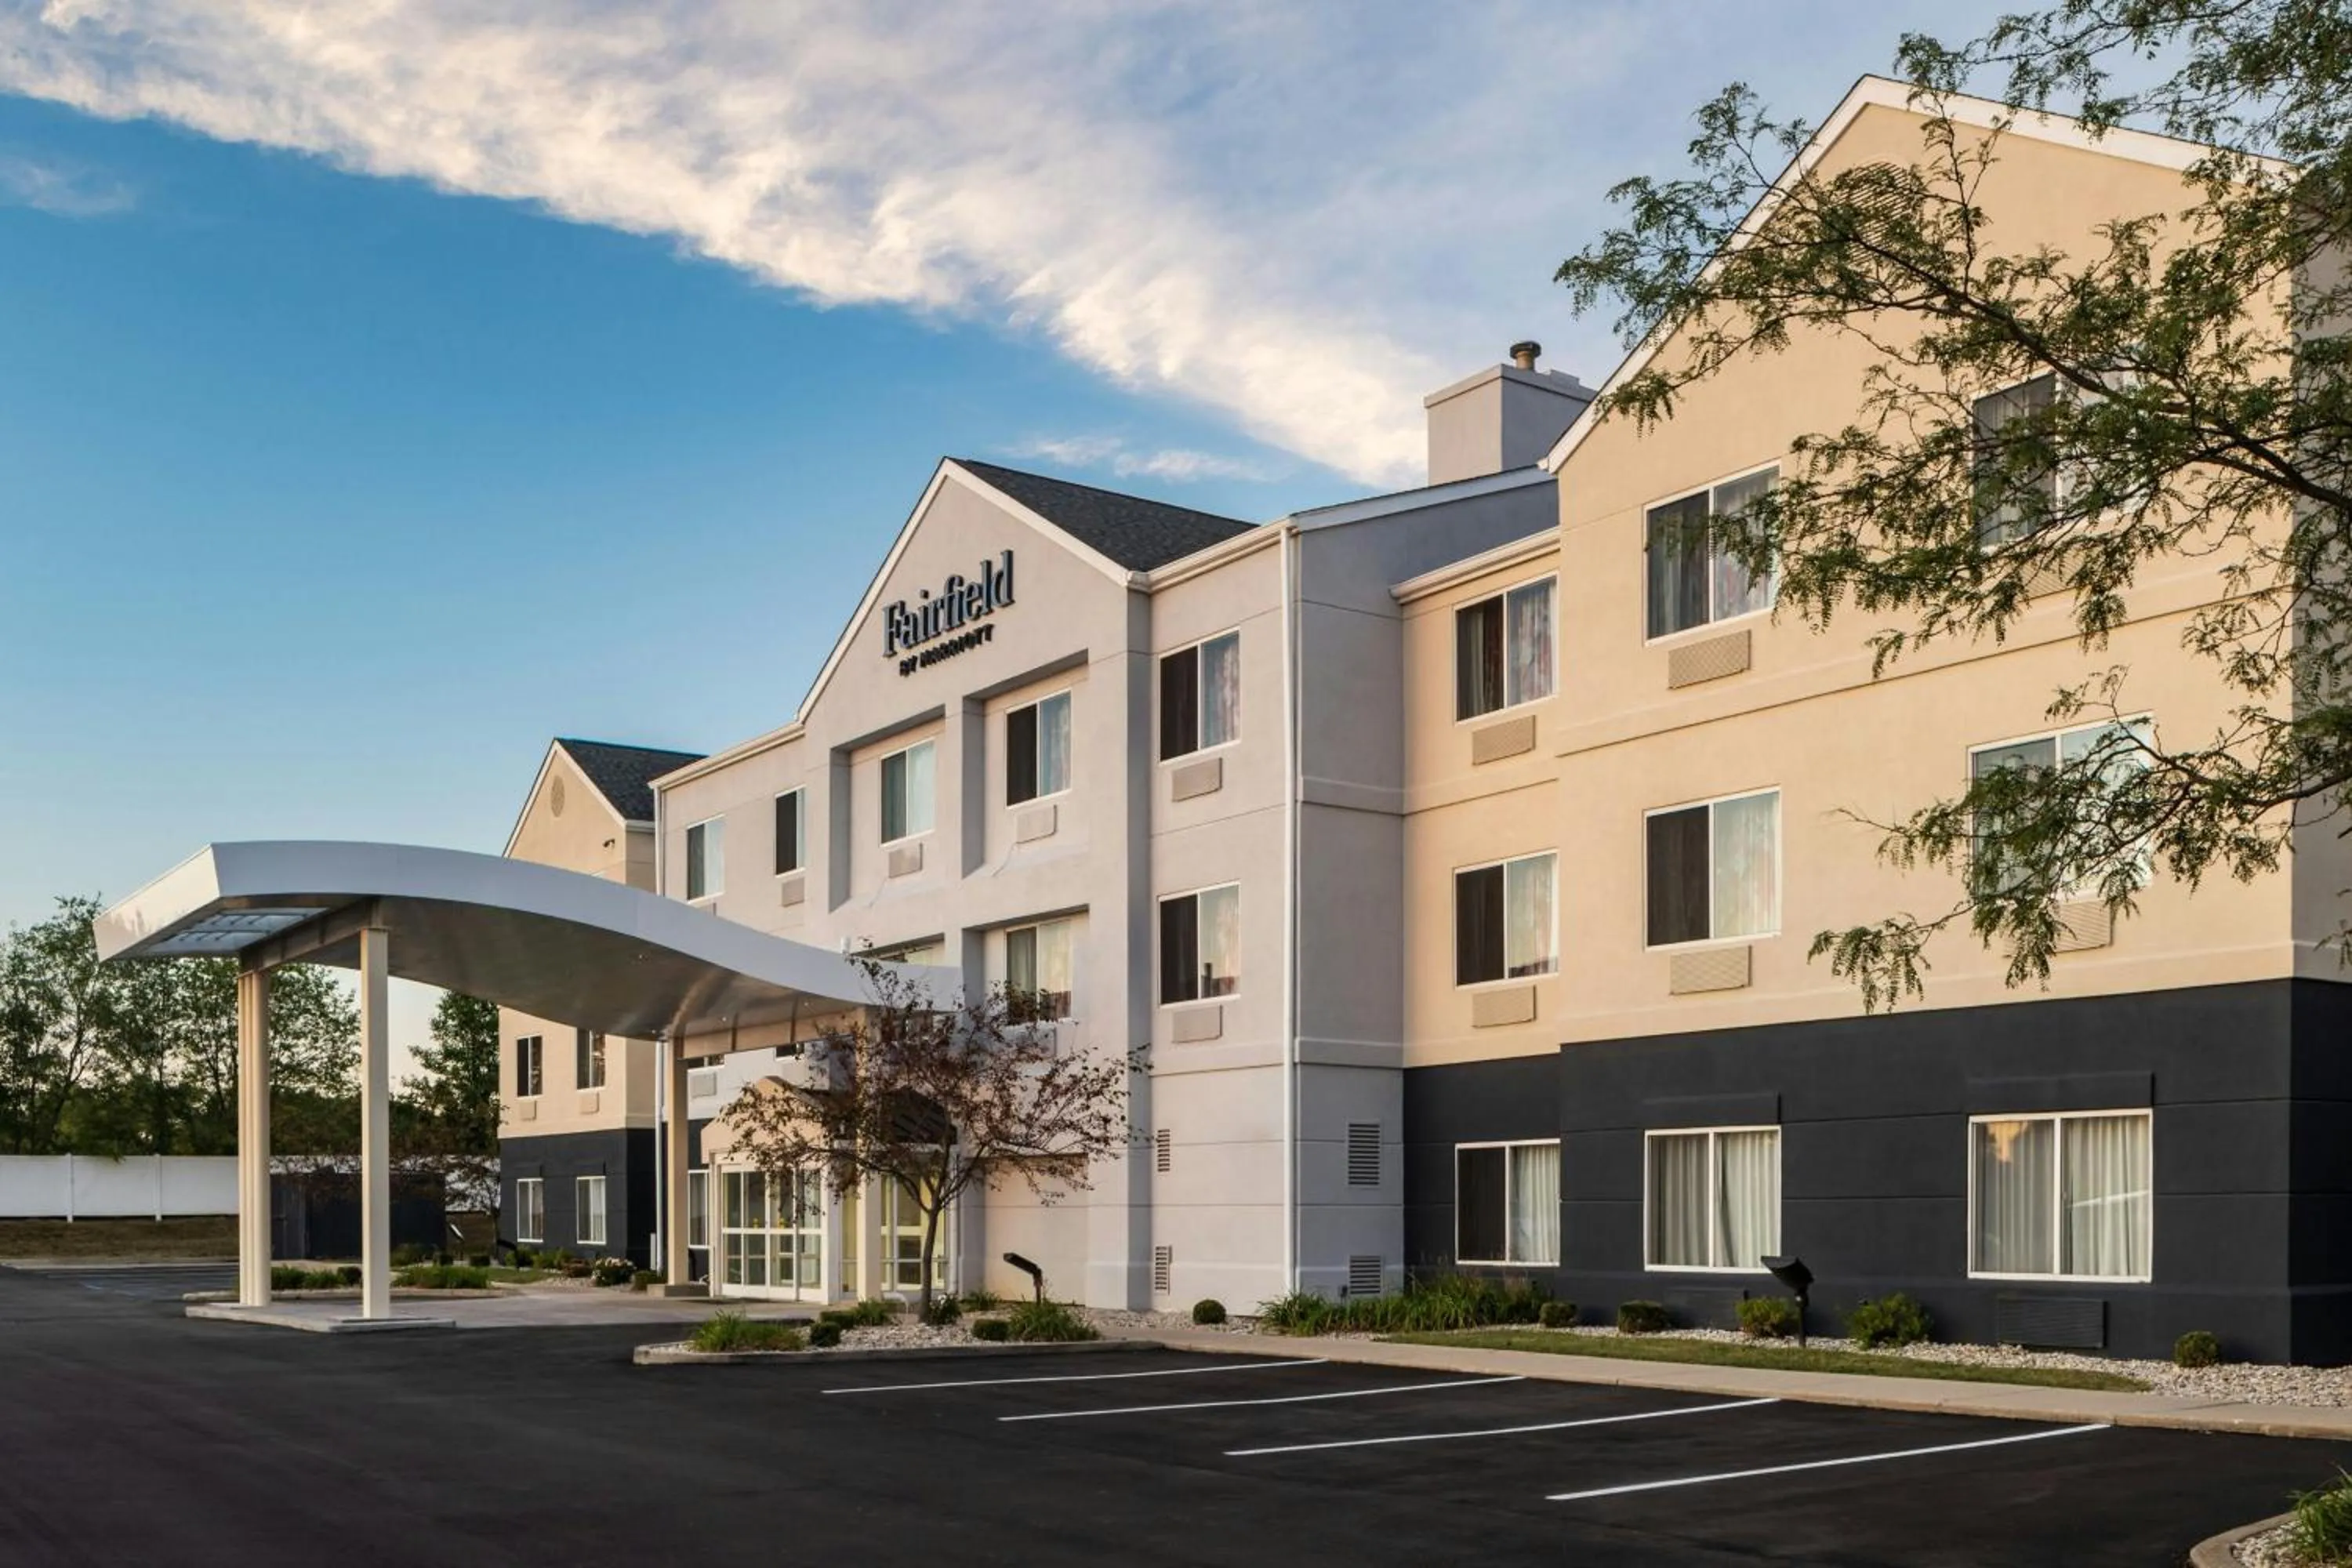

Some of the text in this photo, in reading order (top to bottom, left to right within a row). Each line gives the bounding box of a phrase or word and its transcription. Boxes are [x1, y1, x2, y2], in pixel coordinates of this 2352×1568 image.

[883, 550, 1015, 657] Fairfield
[899, 624, 994, 677] BY MARRIOTT
